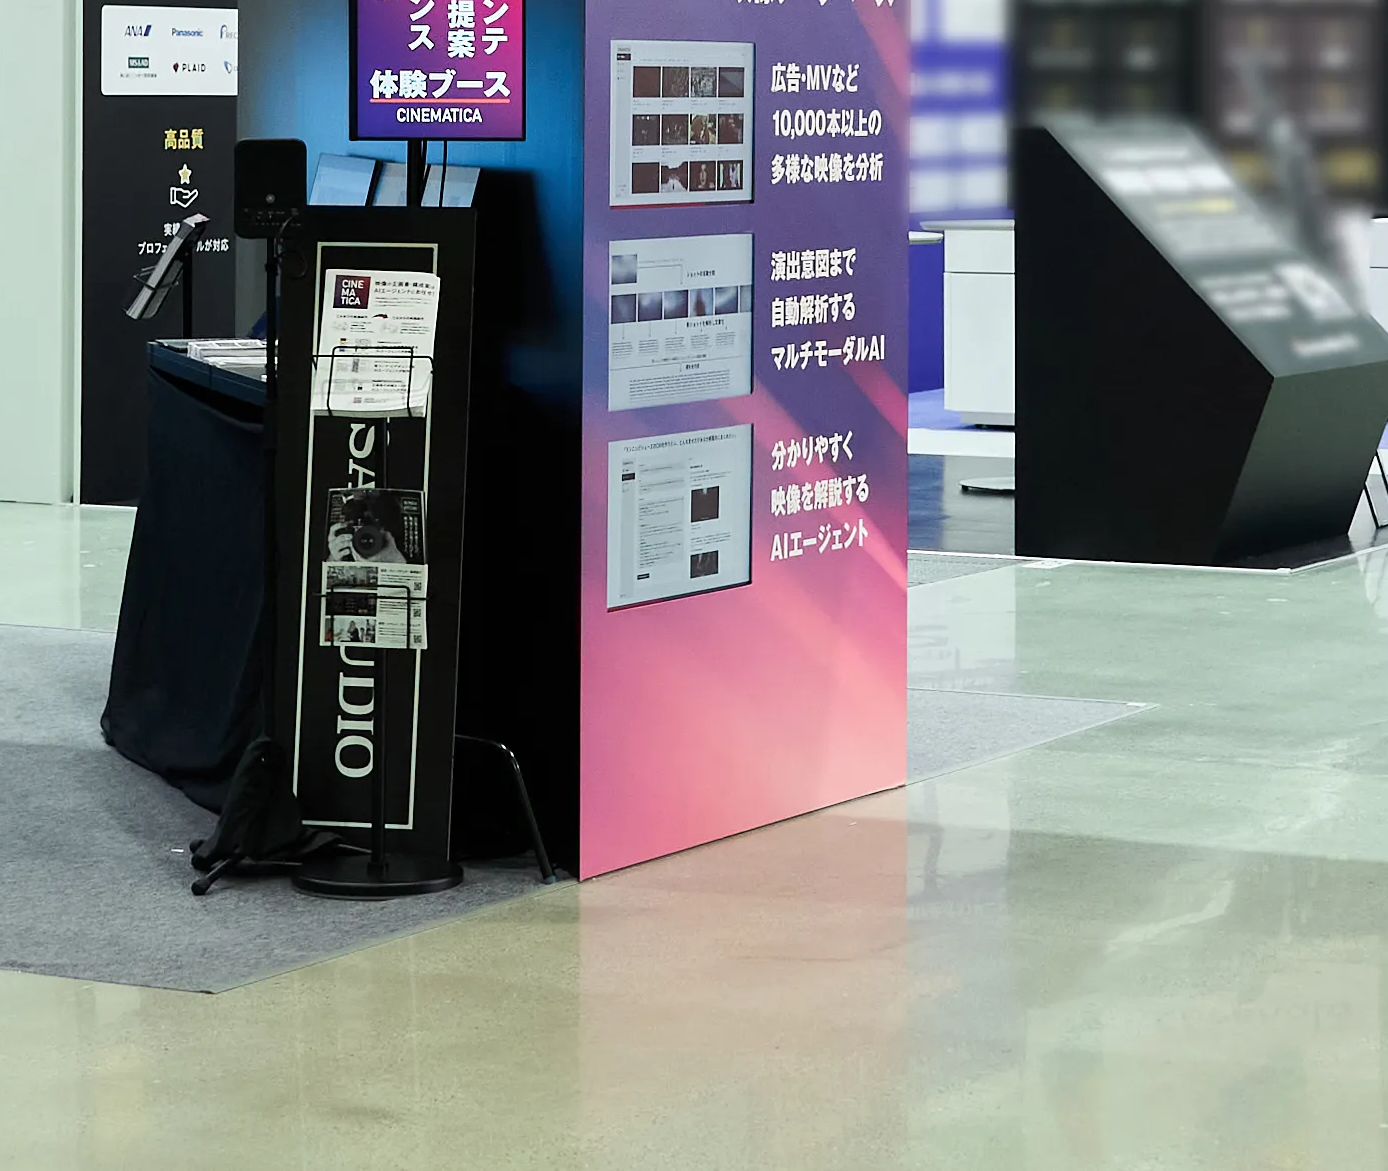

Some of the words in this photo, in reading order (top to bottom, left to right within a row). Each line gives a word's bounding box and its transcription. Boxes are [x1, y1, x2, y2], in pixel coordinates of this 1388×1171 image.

[124, 25, 143, 37] ANA
[171, 27, 204, 37] Panasonic
[182, 63, 207, 73] PLAID
[771, 62, 859, 94] 広告・MVなど
[370, 68, 511, 99] 体験ブース
[396, 107, 483, 123] CINEMATICA
[772, 108, 882, 138] 10,000本以上の
[164, 128, 205, 151] 高品質
[771, 152, 884, 184] 多様な映像を分析
[770, 247, 856, 282] 演出意図まで
[341, 279, 364, 289] CINE
[341, 288, 356, 297] MA
[340, 296, 361, 305] TICA
[771, 292, 856, 328] 自動解析する
[771, 335, 886, 372] マルチモーダルAI
[771, 430, 854, 471] 分かりやすく
[770, 474, 869, 517] 映像を解説する
[770, 518, 869, 562] AIエージェント
